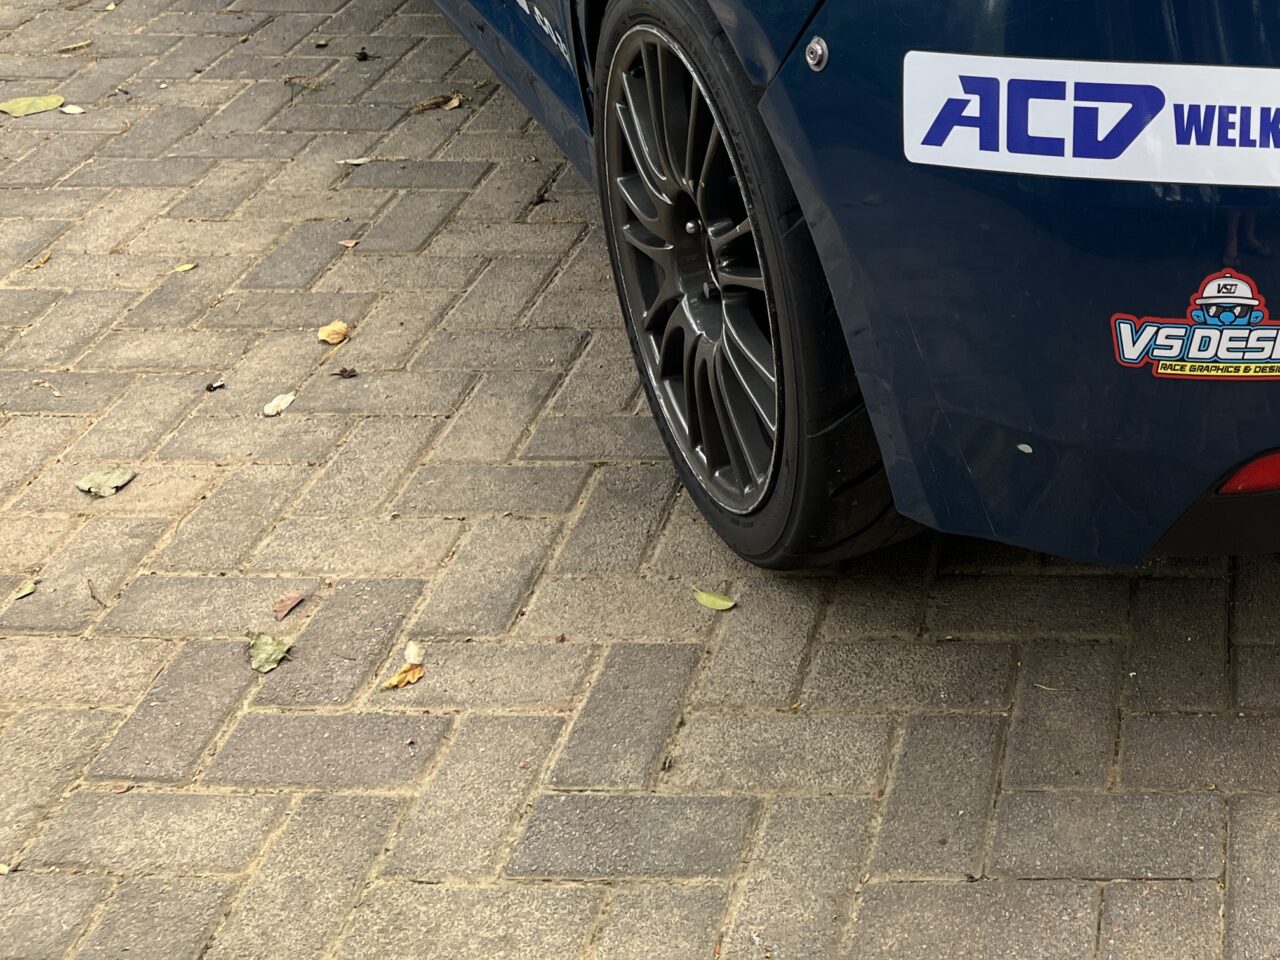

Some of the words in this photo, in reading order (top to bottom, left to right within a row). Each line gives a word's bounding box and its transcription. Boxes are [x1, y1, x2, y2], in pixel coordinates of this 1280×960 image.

[921, 74, 1166, 160] ACD
[1159, 363, 1186, 373] RACE
[1188, 363, 1242, 374] GRAPHICS
[1243, 364, 1252, 374] &
